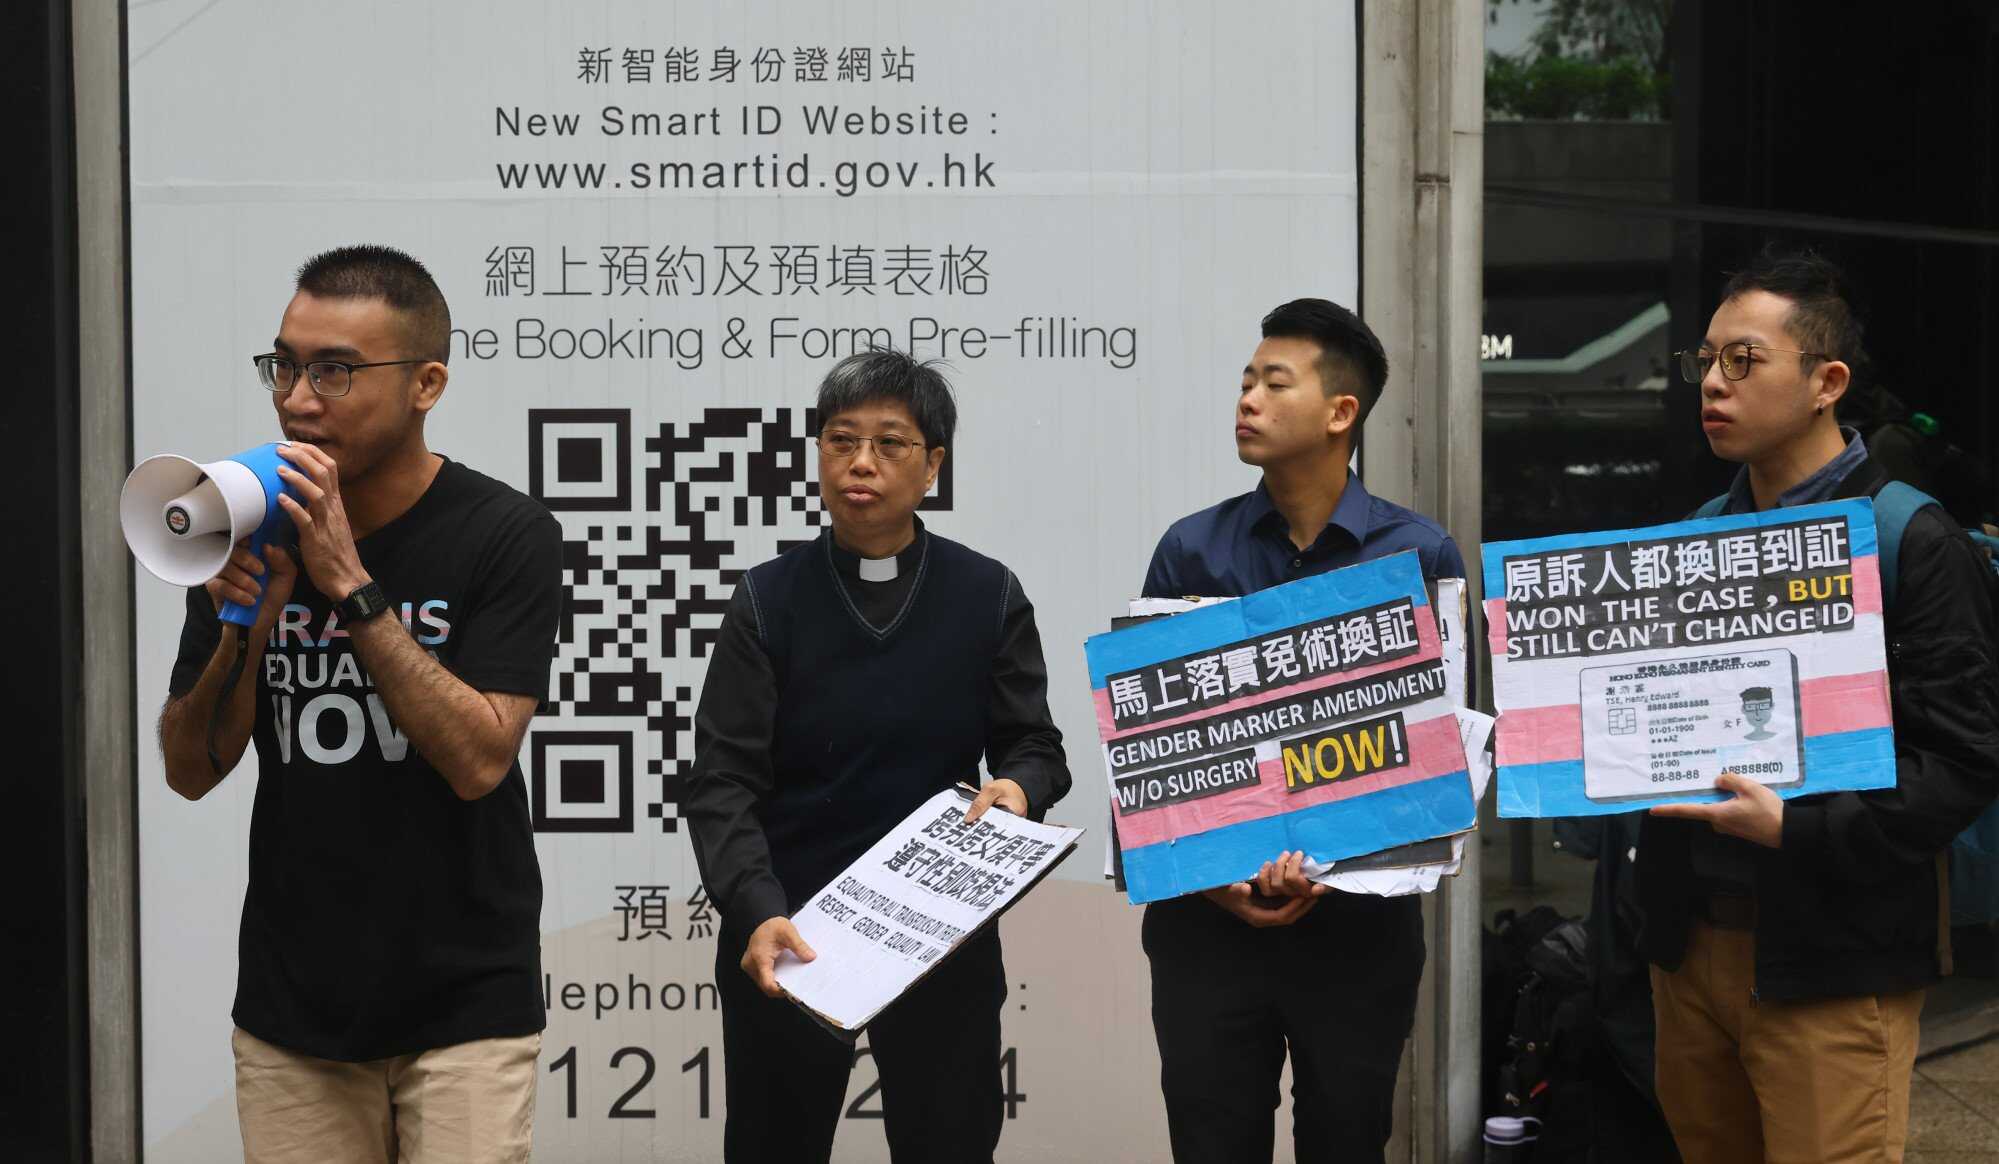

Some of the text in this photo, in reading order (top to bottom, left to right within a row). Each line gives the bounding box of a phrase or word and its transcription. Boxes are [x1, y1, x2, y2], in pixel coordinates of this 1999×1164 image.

[578, 46, 914, 83] 新智能身份證網站
[497, 107, 579, 136] New
[602, 107, 720, 135] Smart
[743, 106, 781, 134] ID
[803, 106, 967, 134] Website
[497, 153, 995, 197] www.smartid.gov.hk
[486, 245, 988, 296] 網上預約及預填表格
[517, 319, 702, 369] Booking
[722, 318, 752, 358] &
[770, 317, 892, 360] Form
[909, 317, 1138, 370] Pre-filling
[1506, 521, 1849, 603] 原訴人都換唔到証
[1506, 604, 1586, 632] WON
[1607, 597, 1660, 624] THE
[1789, 574, 1853, 602] BUT
[1507, 602, 1854, 659] STILL CAN'T CHANGE ID
[1109, 604, 1418, 721] 馬上落實免術換証
[1109, 665, 1445, 769] GENDER MARKER AMENDMENT
[1283, 719, 1405, 787] NOW!
[1115, 756, 1258, 809] W/O SURGERY
[816, 893, 857, 925] RESPECT
[852, 916, 889, 943] GENDER
[884, 931, 925, 956] EQUALITY
